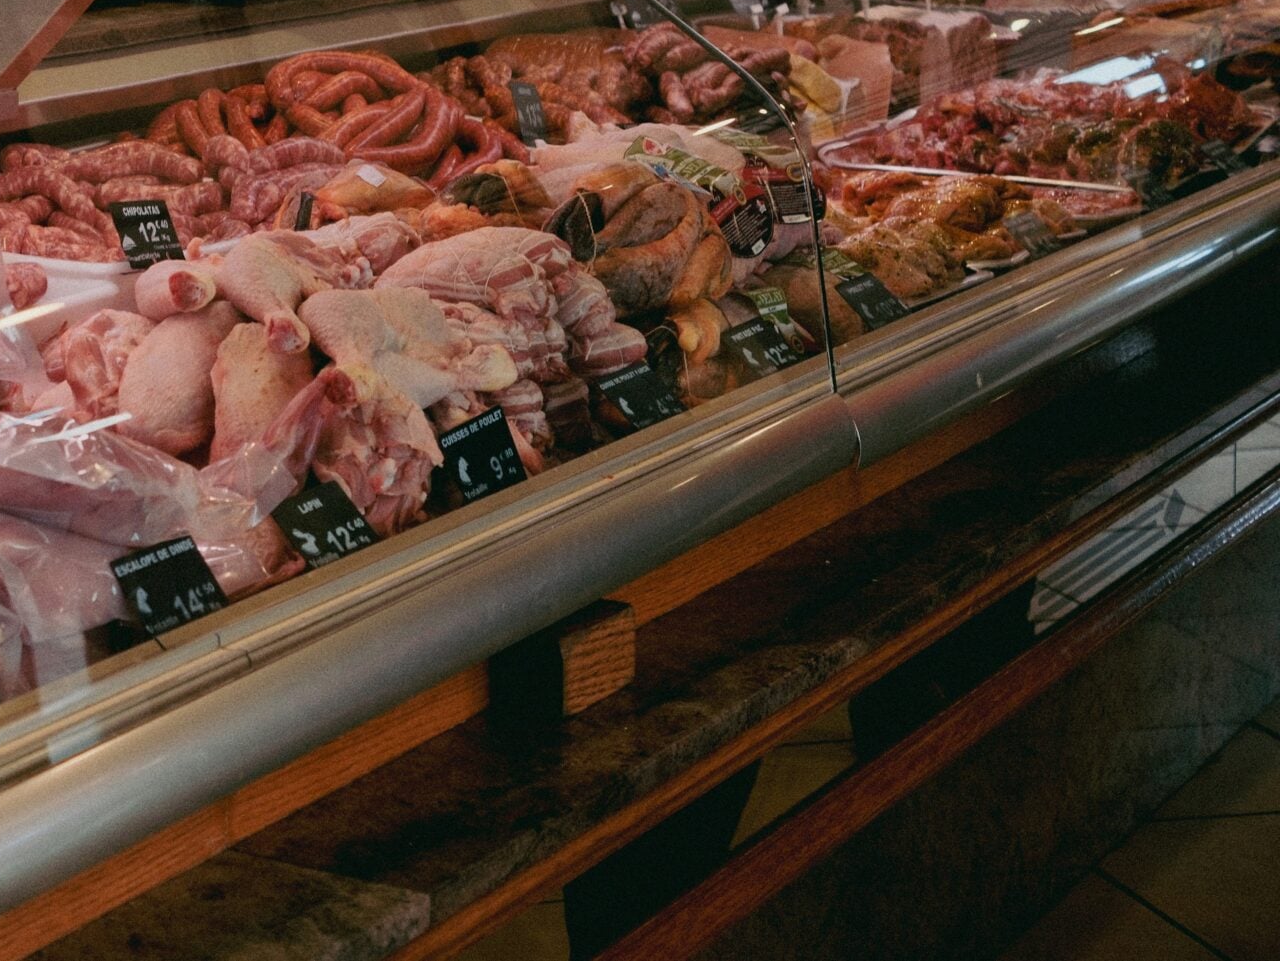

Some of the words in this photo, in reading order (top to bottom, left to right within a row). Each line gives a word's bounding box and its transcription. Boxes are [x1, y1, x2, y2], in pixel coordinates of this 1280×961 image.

[122, 205, 160, 216] CHIPOLATAS
[138, 222, 160, 242] 12
[441, 427, 469, 448] CUISSES
[469, 422, 480, 433] DE
[480, 409, 502, 428] POULET
[490, 456, 503, 480] 9
[297, 498, 323, 515] LAPIN
[327, 526, 358, 552] 12
[115, 552, 158, 577] ESCALOPE
[156, 548, 170, 560] DE
[168, 538, 194, 556] DINDE
[174, 588, 204, 618] 14
